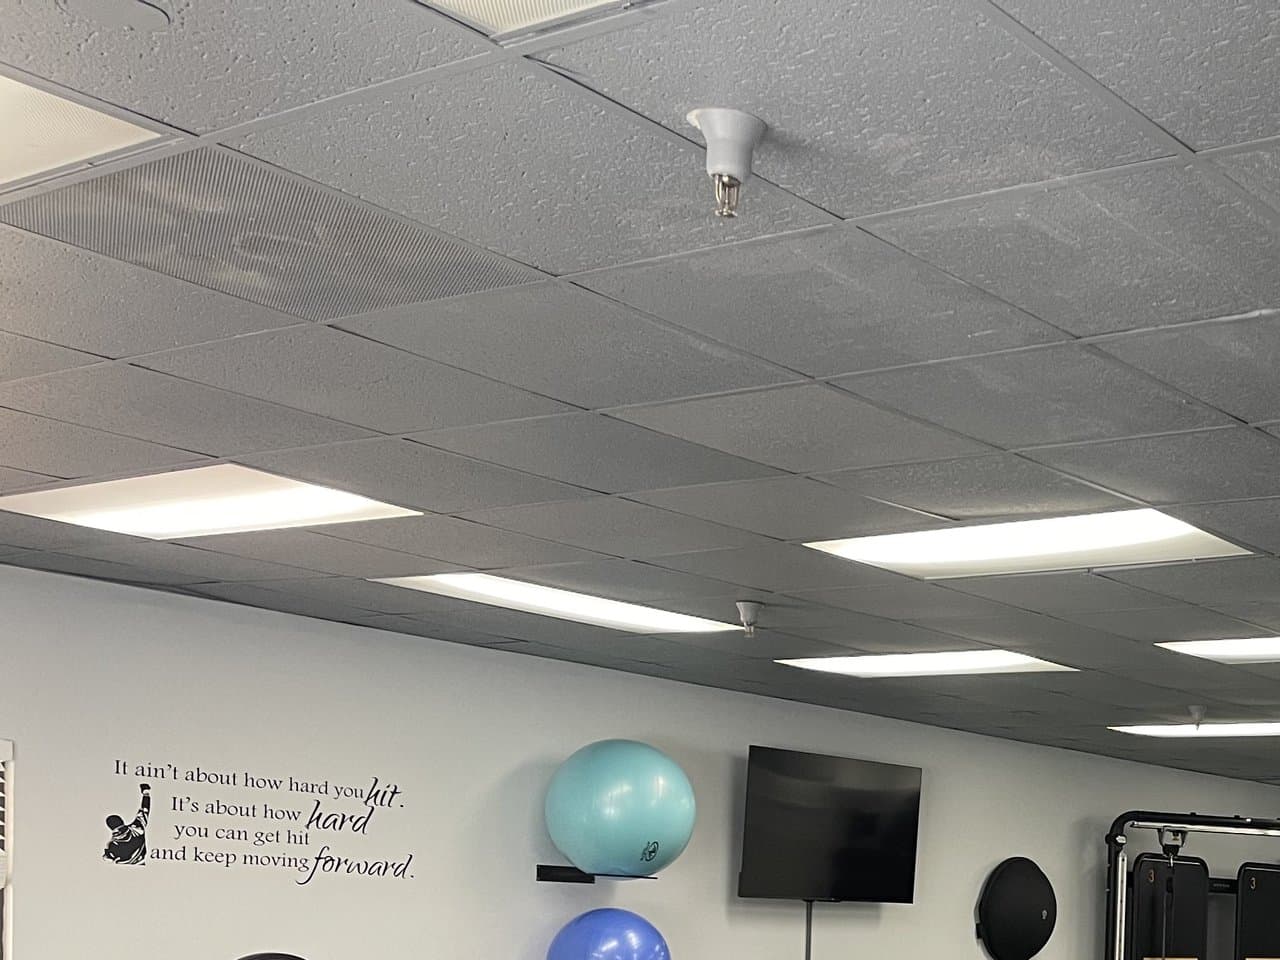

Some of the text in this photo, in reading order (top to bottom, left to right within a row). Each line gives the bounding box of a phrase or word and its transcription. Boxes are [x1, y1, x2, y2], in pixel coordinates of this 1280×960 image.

[114, 760, 405, 808] It ain't about how hard you hit.
[171, 796, 374, 834] It's about how hard
[174, 824, 310, 845] you can get hit
[150, 846, 414, 885] and keep moving forward.
